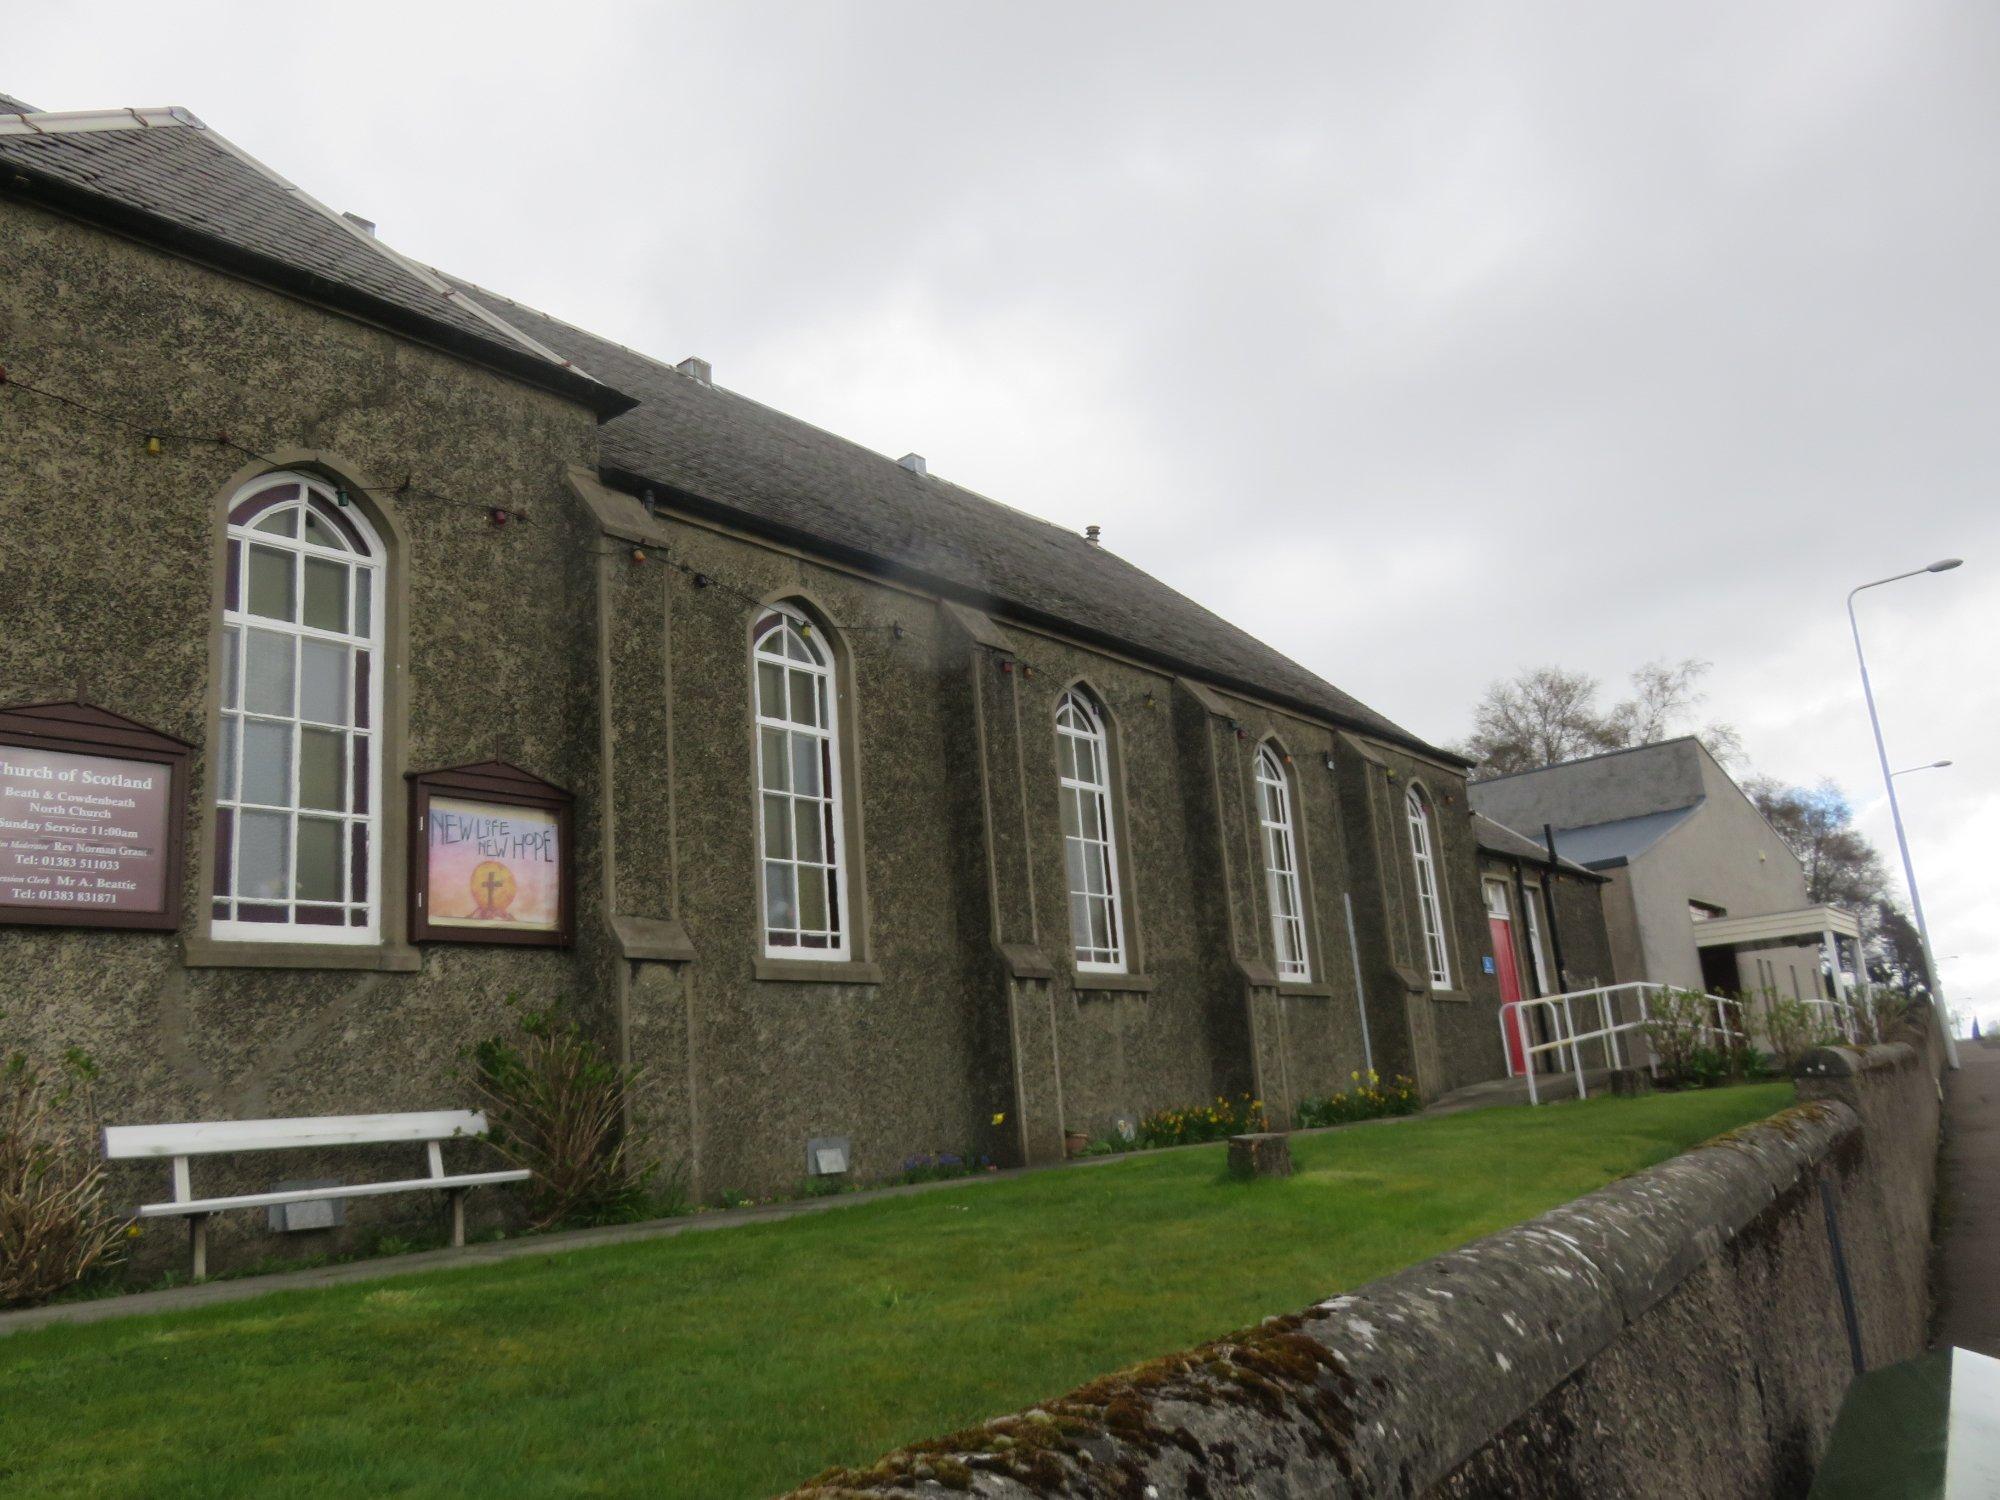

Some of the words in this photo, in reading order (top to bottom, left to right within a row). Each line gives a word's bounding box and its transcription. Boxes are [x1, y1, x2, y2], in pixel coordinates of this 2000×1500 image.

[0, 762, 53, 780] hurch
[58, 769, 78, 783] of
[82, 770, 153, 789] Scotland
[5, 787, 40, 799] Beath
[43, 792, 53, 800] &
[57, 792, 136, 808] Cowdenbeath
[30, 803, 65, 815] North
[69, 807, 112, 818] Church
[0, 818, 41, 832] Sunday
[45, 822, 87, 834] Service
[91, 826, 138, 838] 11:00am
[431, 814, 474, 847] NEW
[54, 842, 72, 851] Rev
[76, 843, 116, 855] Norman
[478, 837, 508, 858] NEW
[15, 854, 38, 865] Tel:
[42, 856, 77, 868] 01383
[80, 859, 120, 870] 511033
[0, 875, 24, 883] ession
[27, 876, 50, 885] Clerk
[57, 876, 76, 886] Mr
[78, 878, 93, 887] A.
[97, 879, 137, 890] Beattie
[12, 888, 35, 899] Tel:
[39, 889, 74, 901] 01383
[77, 892, 117, 903] 831871
